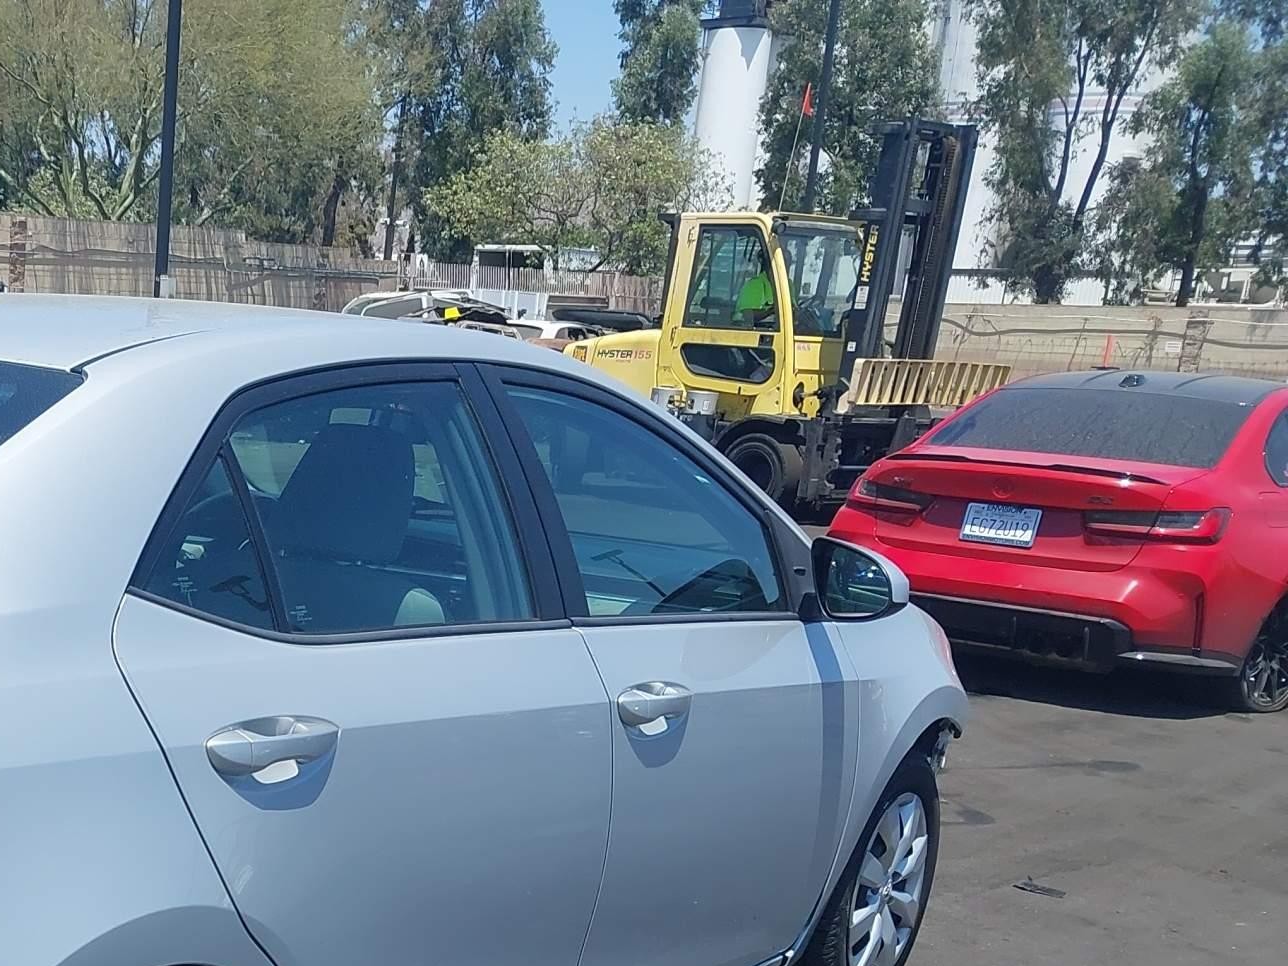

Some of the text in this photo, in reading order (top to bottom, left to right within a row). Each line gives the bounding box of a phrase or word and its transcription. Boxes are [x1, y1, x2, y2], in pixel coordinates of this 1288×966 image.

[860, 224, 880, 282] HYSTER
[597, 349, 632, 359] HYSTER
[633, 350, 652, 360] 155
